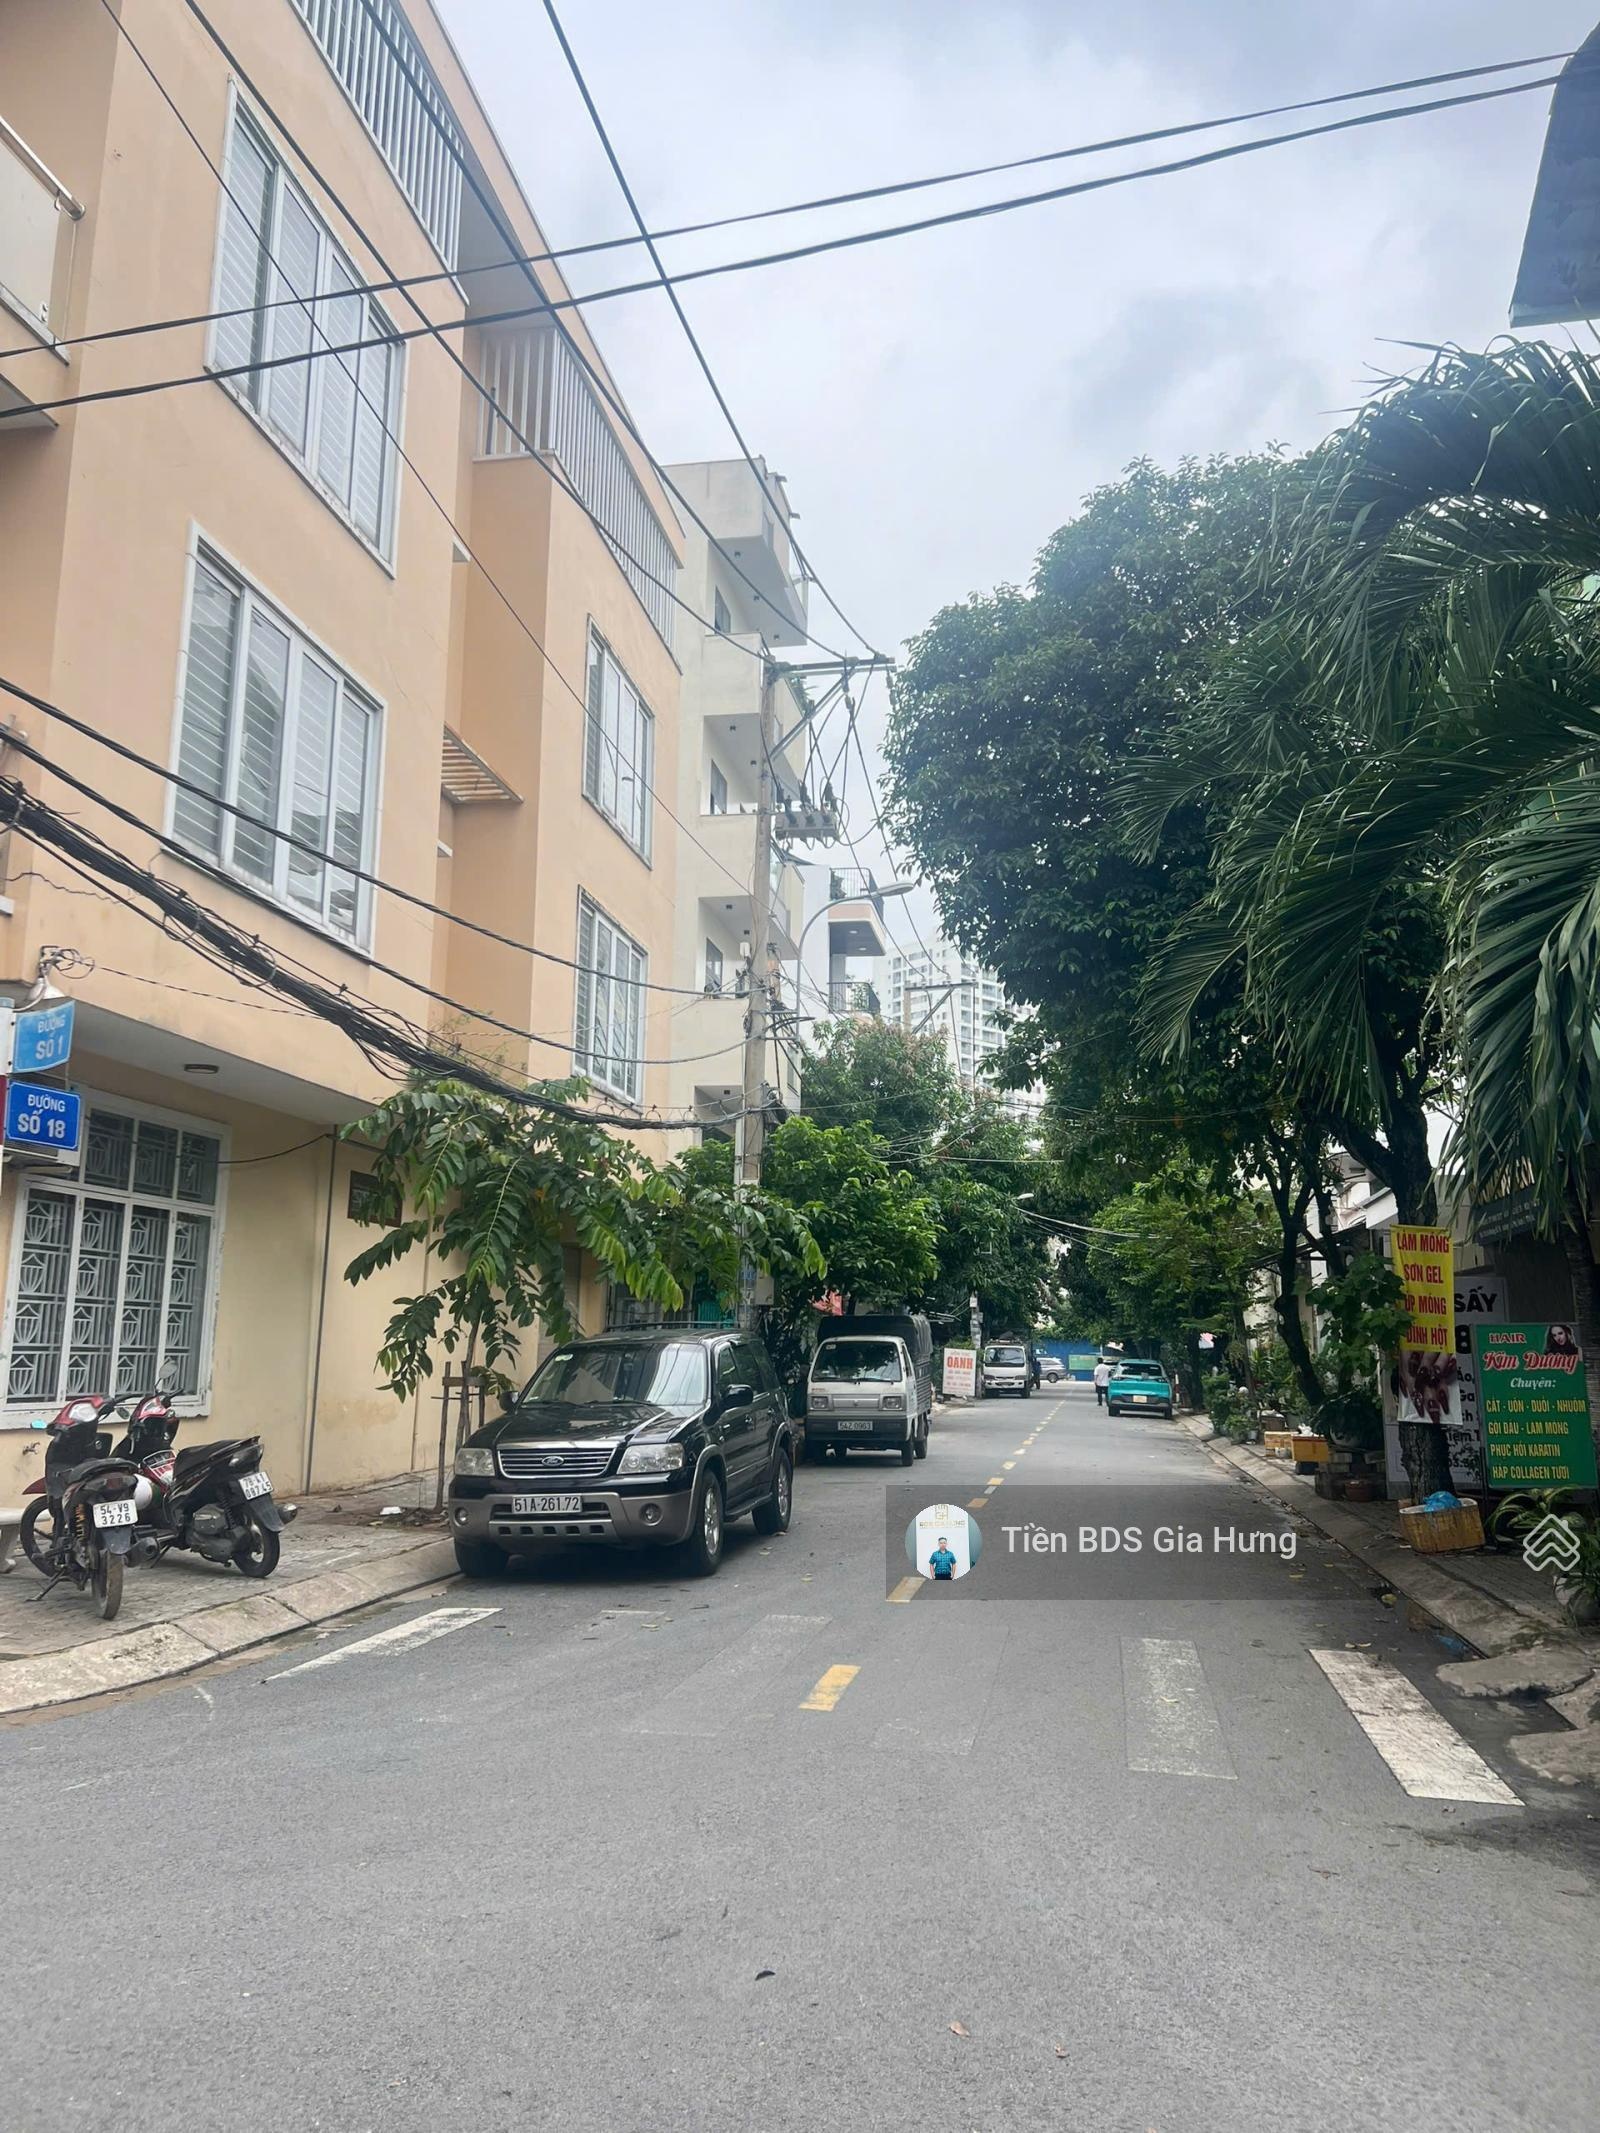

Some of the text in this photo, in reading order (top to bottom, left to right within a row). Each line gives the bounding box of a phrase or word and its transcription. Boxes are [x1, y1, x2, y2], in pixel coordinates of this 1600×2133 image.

[36, 1032, 63, 1059] SỐ 1
[28, 1094, 66, 1112] ĐƯỜNG
[18, 1109, 66, 1138] SỐ 18
[1420, 1231, 1449, 1253] MÓNG
[1404, 1263, 1443, 1284] SƠN GEL
[1454, 1286, 1497, 1312] SẤY
[1489, 1333, 1527, 1344] HAIR
[947, 1356, 973, 1369] OANH
[1483, 1352, 1519, 1370] Kim
[1510, 1377, 1557, 1390] Chuyên:
[1511, 1466, 1550, 1478] COLLAGEN
[101, 1503, 129, 1514] 54-V9
[514, 1496, 579, 1512] 51A-261.72
[101, 1513, 130, 1525] 3226
